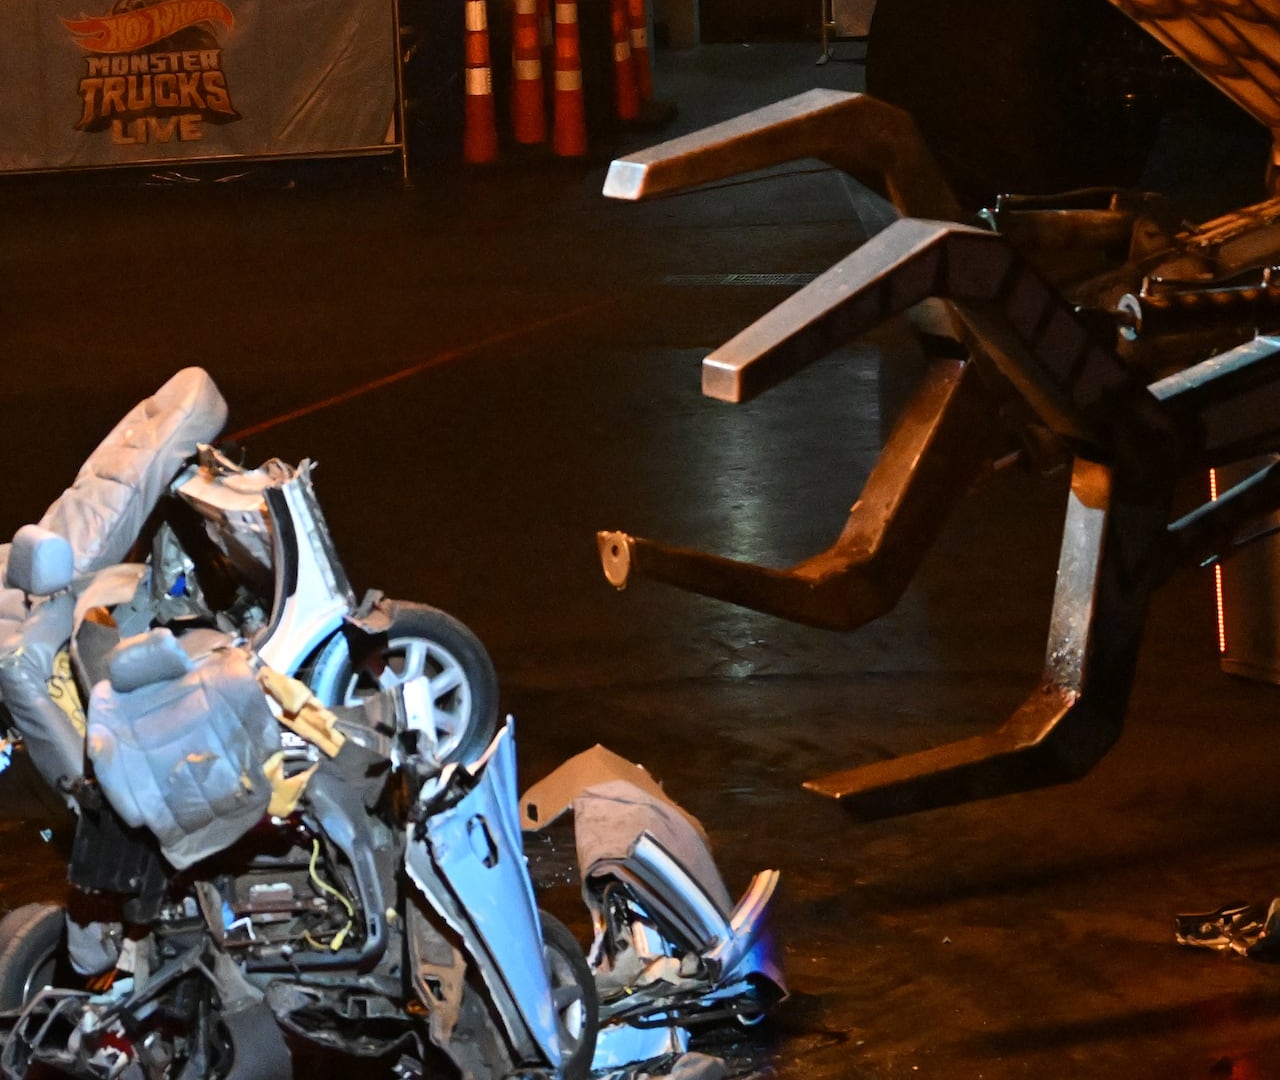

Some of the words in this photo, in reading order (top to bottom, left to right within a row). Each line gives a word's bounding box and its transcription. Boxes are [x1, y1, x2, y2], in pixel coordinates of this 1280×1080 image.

[105, 14, 148, 50] HOT
[86, 49, 221, 76] MONSTER
[75, 71, 239, 129] TRUCKS
[112, 114, 202, 145] LIVE
